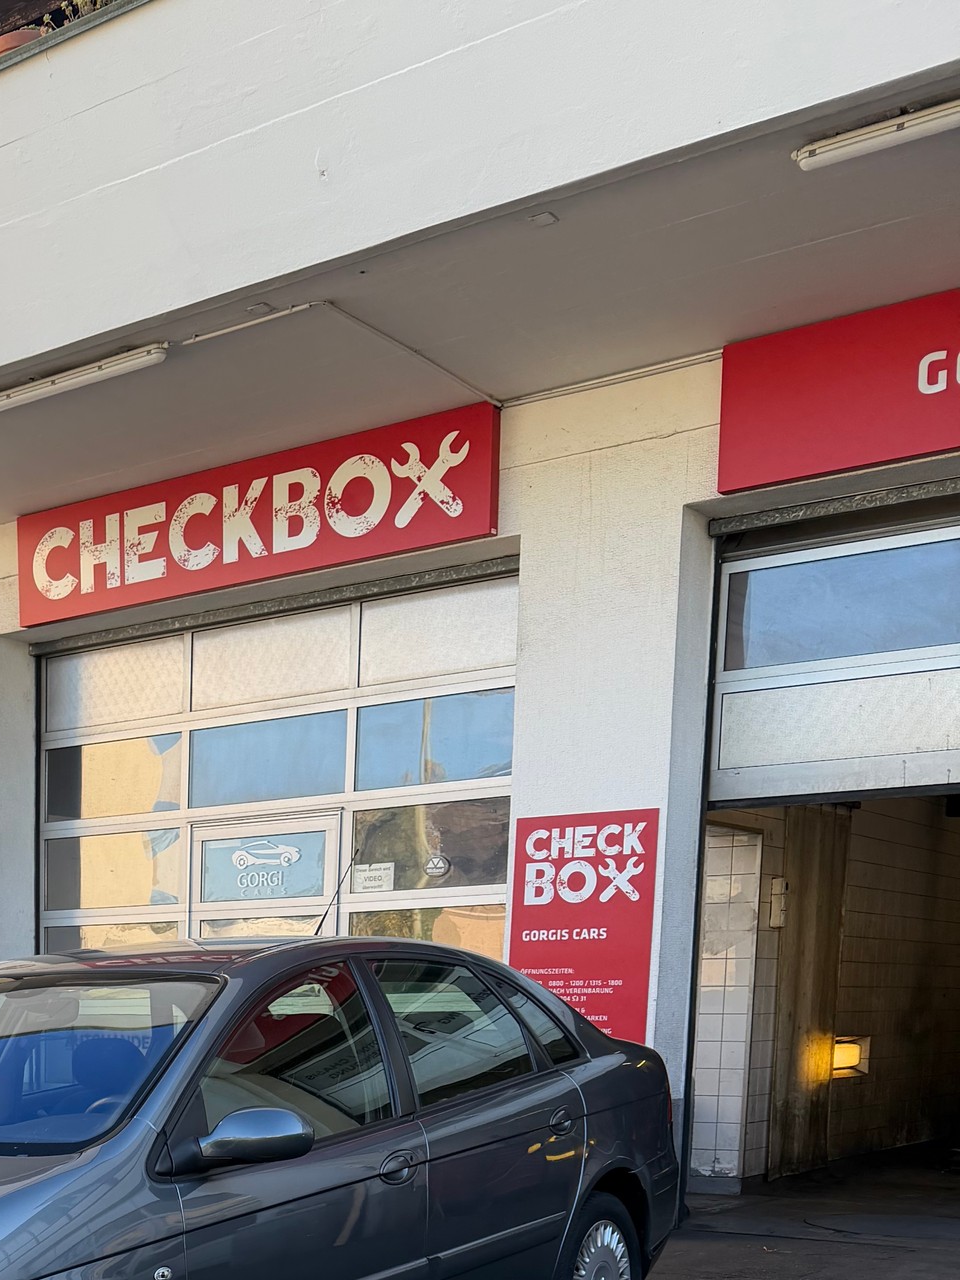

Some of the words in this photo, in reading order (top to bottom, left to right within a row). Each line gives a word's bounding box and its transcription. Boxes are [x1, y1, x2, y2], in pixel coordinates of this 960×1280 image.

[917, 350, 960, 395] G
[32, 430, 471, 600] CHECKBOX
[525, 822, 647, 860] CHECK
[237, 871, 284, 888] GORGI
[240, 887, 287, 897] CARS
[523, 856, 645, 906] BOX
[522, 928, 569, 942] GORGIS
[572, 927, 607, 940] CARS
